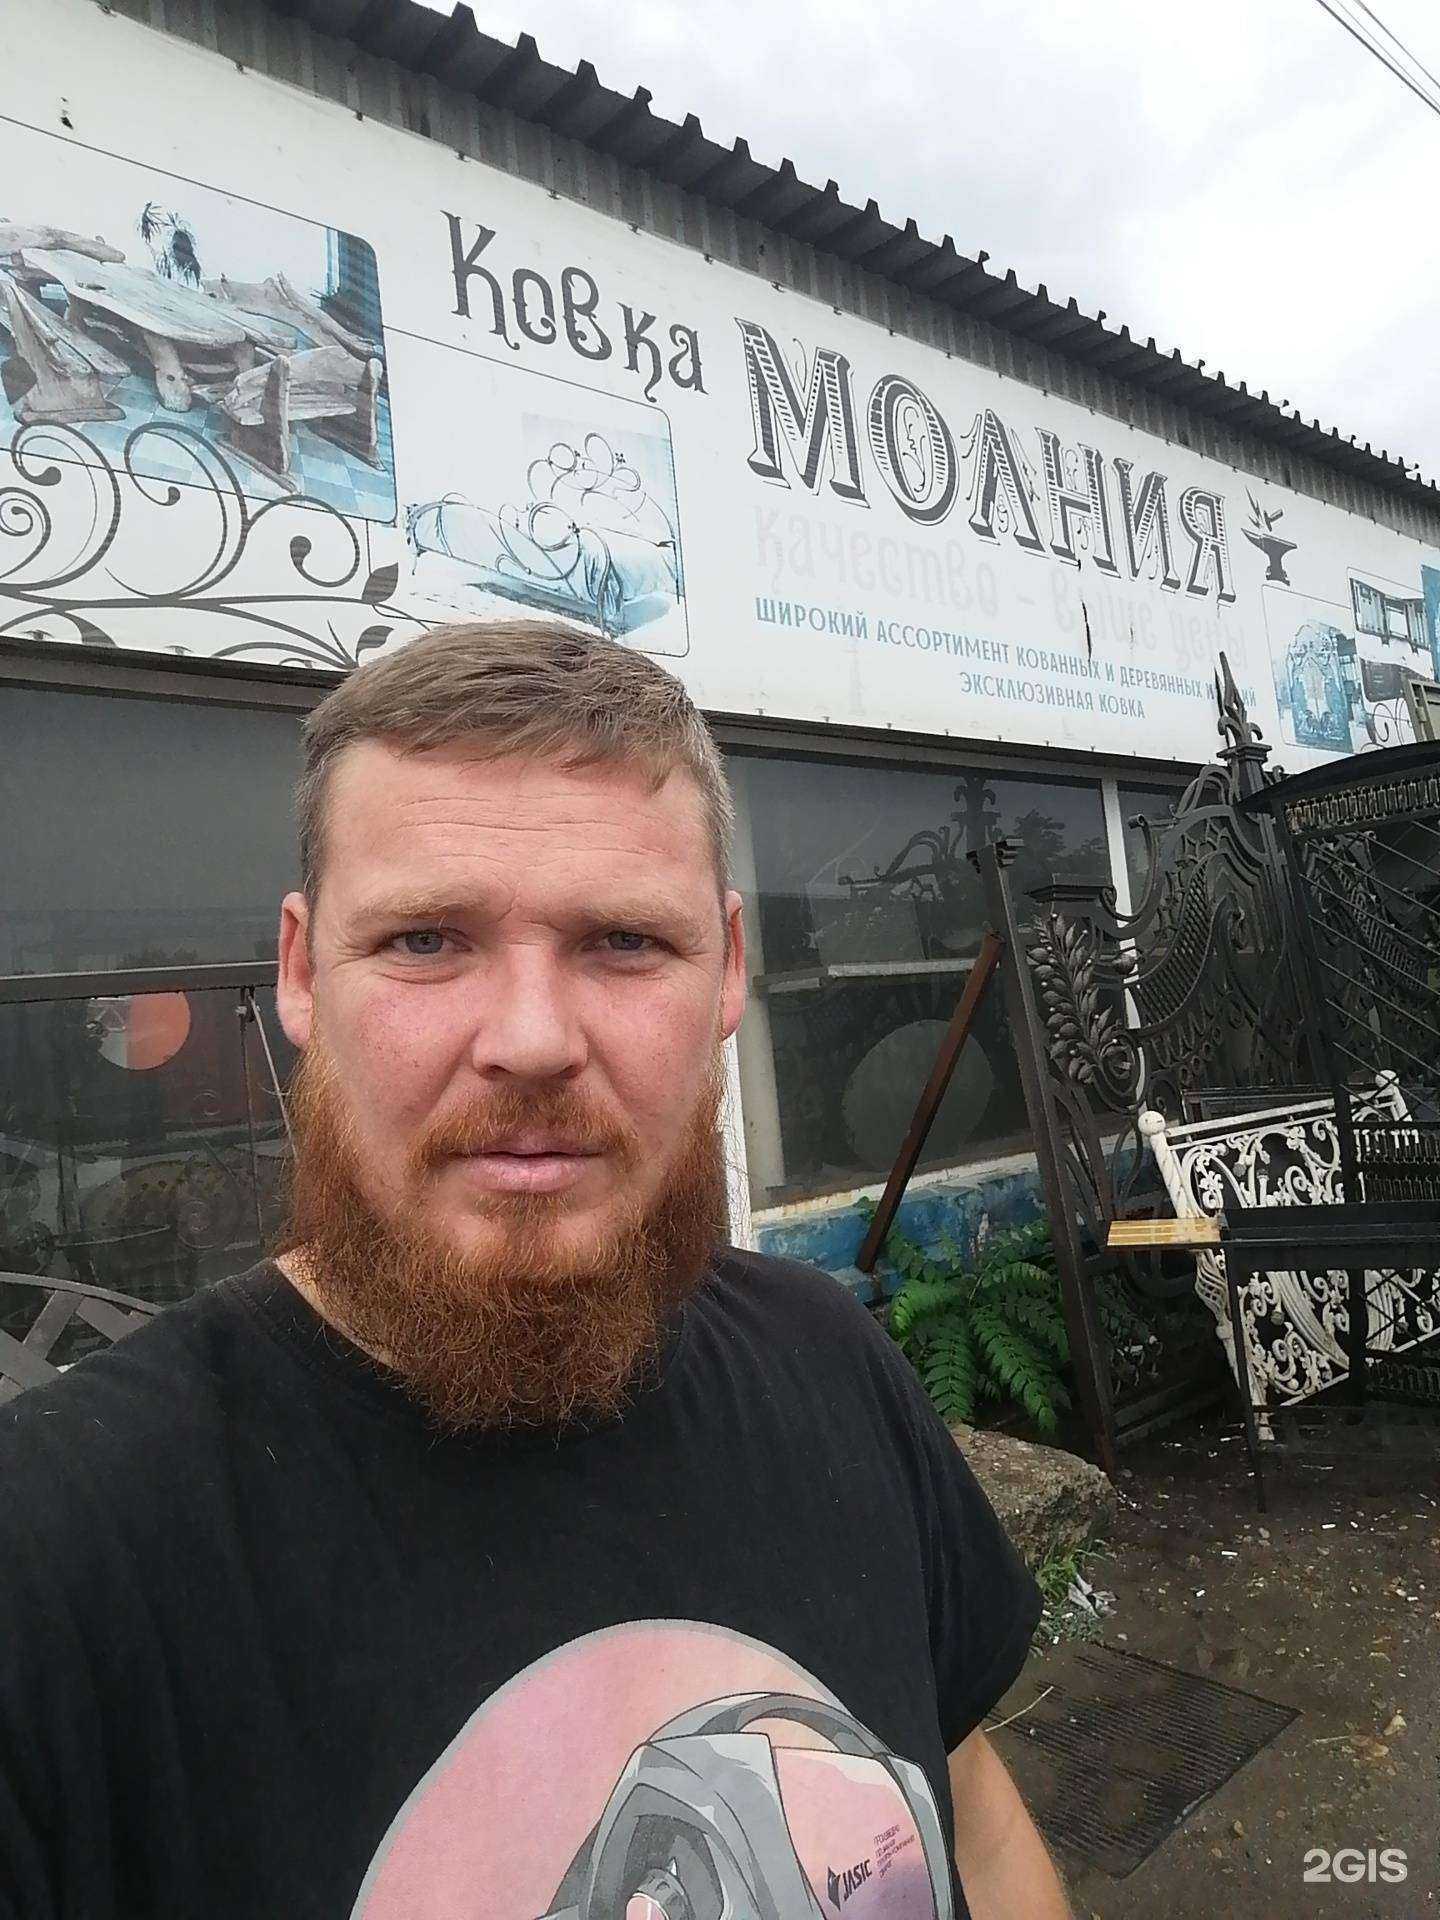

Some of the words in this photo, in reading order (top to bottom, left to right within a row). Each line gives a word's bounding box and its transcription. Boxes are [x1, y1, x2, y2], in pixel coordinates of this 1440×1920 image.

[440, 209, 710, 403] Ковка
[735, 317, 1237, 605] МОЛНИЯ
[755, 597, 869, 640] ШИРОКИЙ
[876, 620, 1010, 664] АССОРТИМЕНТ
[1016, 646, 1100, 679] КОВАННЫХ
[1104, 662, 1115, 683] И
[1120, 665, 1202, 699] ДЕРЕВЯННЫХ
[960, 671, 1094, 711] ЭКСКЛЮЗИВНАЯ
[1099, 694, 1146, 719] КОВКА
[842, 1858, 873, 1902] JASIC
